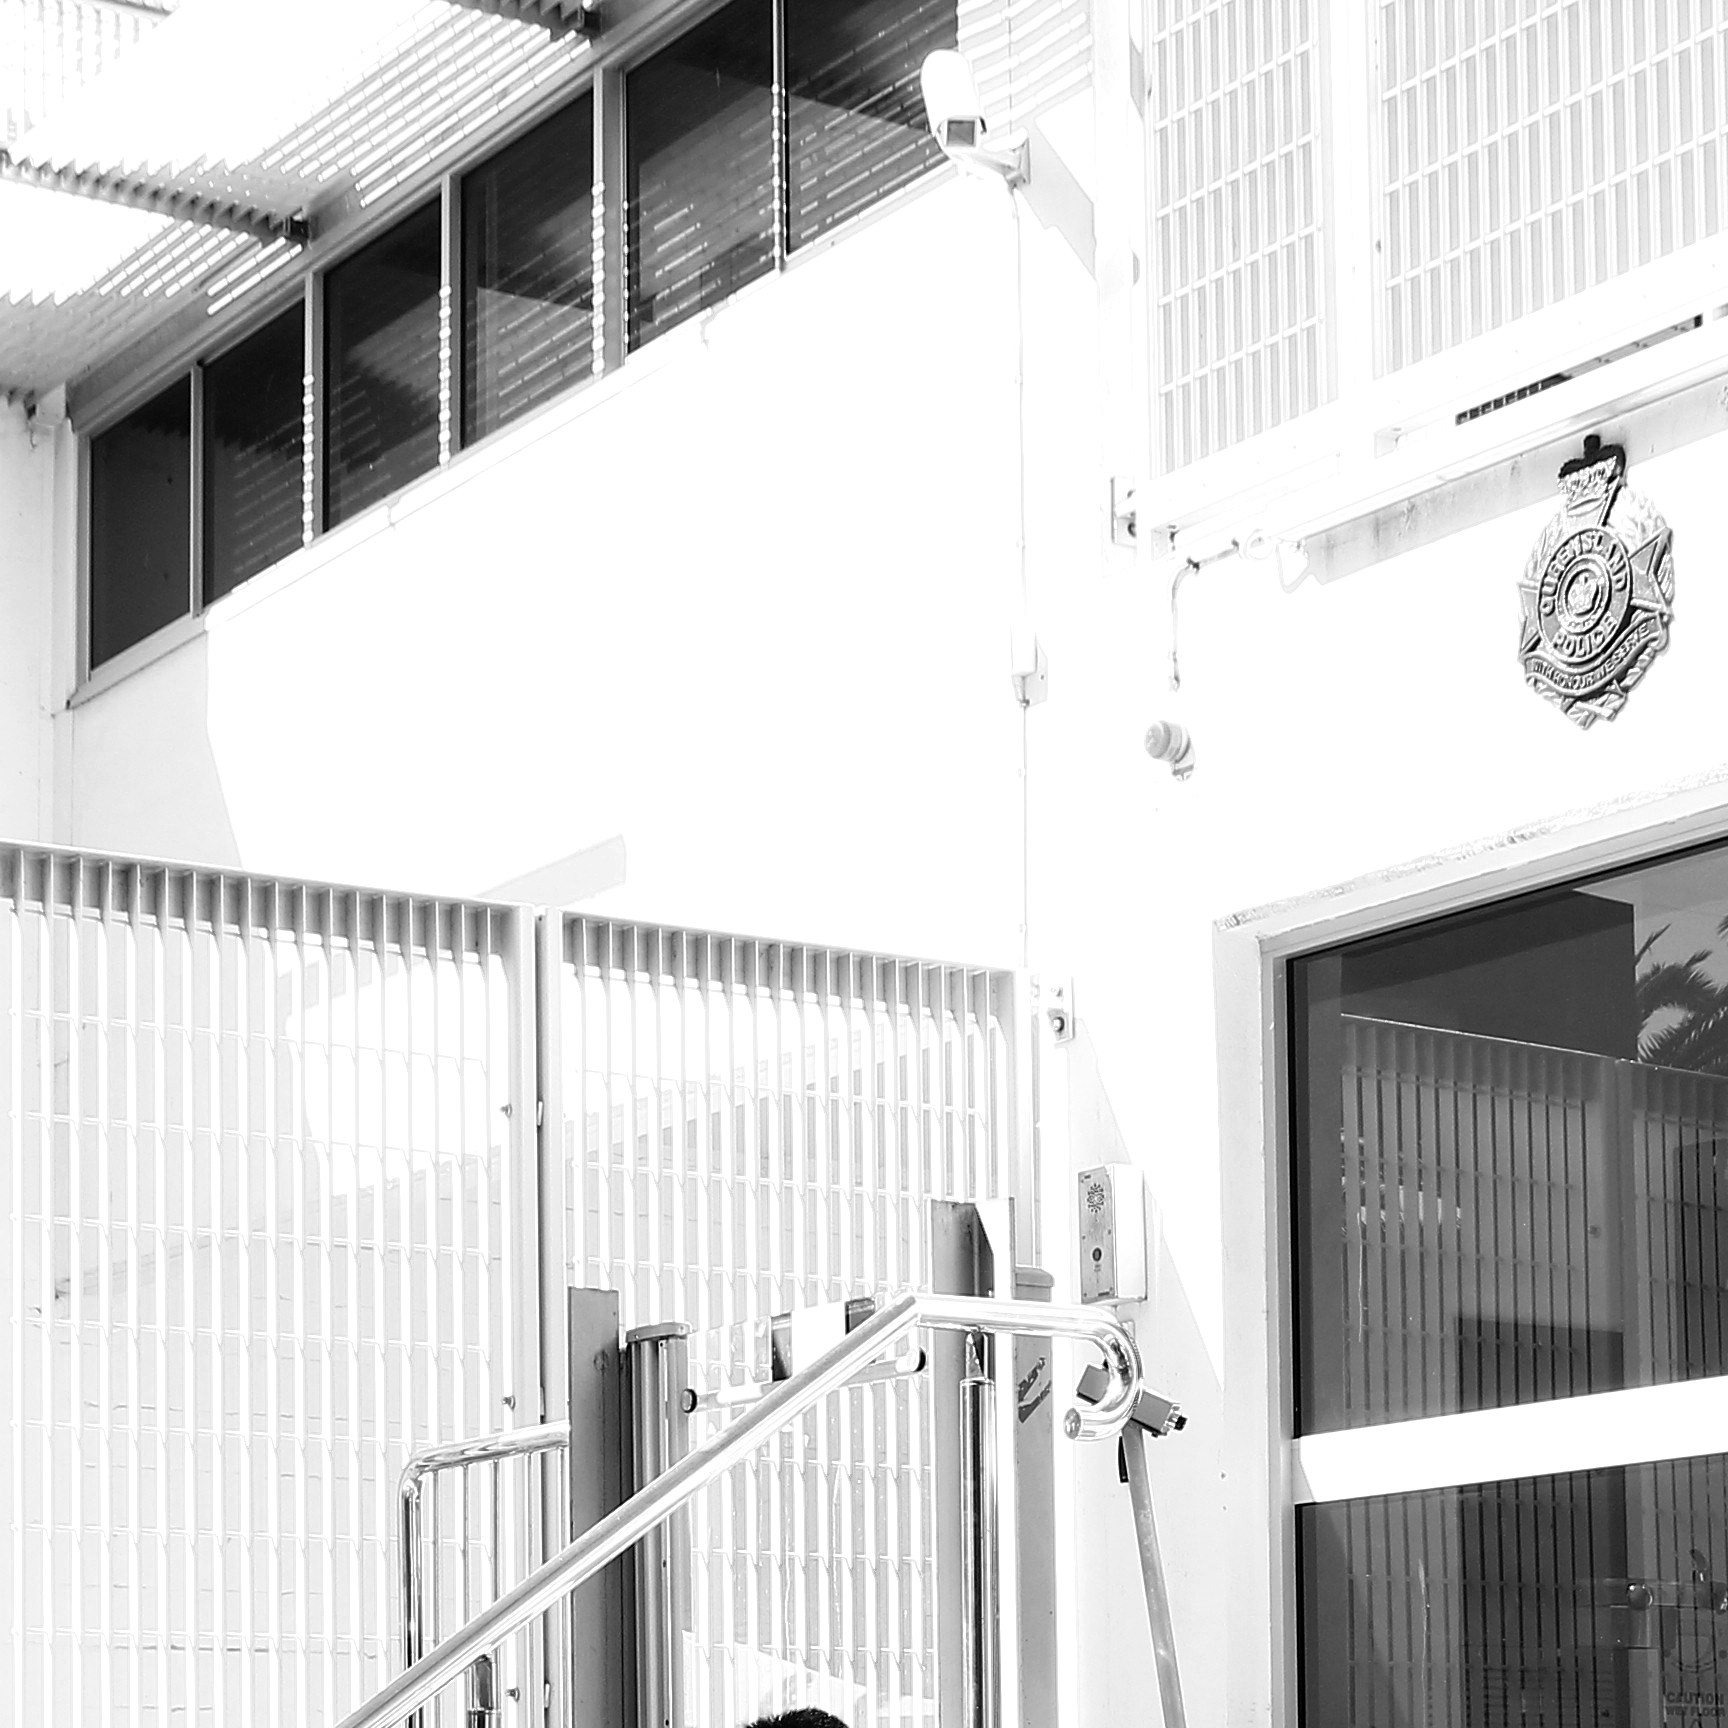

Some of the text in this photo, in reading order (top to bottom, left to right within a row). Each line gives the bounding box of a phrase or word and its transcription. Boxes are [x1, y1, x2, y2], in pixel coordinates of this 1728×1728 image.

[1540, 533, 1628, 617] QUEENSLAND
[1552, 610, 1617, 658] POLICE
[1667, 1692, 1725, 1705] CAUTION
